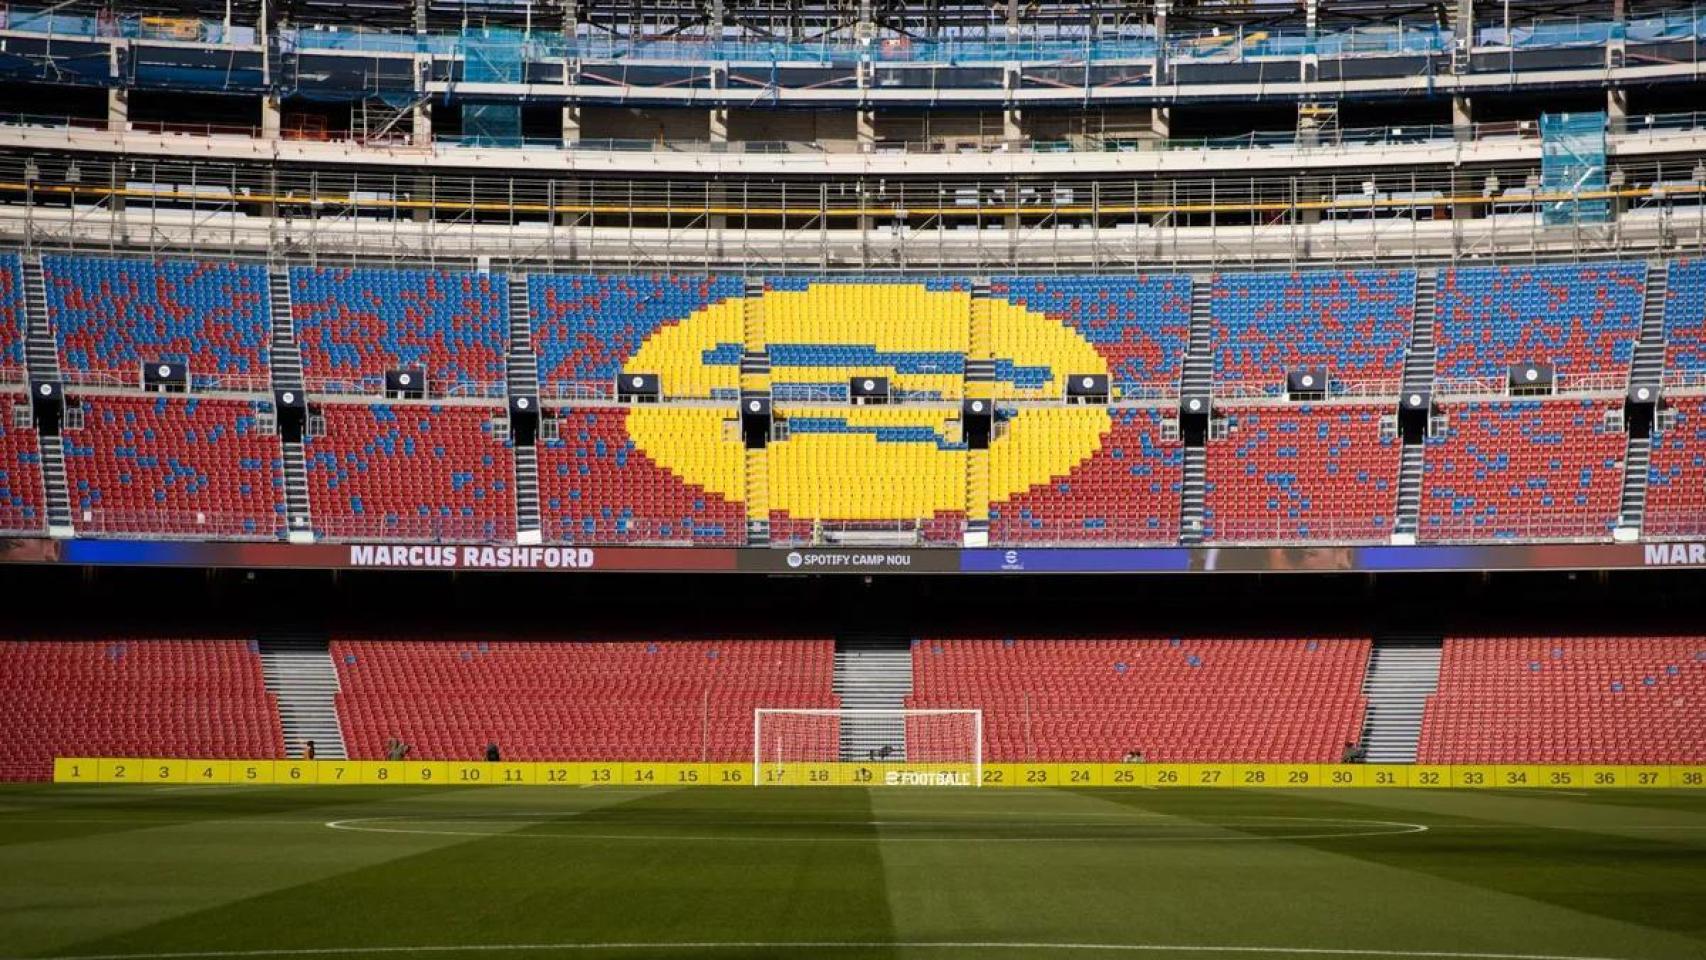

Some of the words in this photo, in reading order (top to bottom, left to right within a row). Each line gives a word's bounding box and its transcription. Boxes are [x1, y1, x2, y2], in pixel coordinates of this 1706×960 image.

[350, 545, 457, 567] MARCUS
[463, 547, 594, 568] RASHFORD
[804, 554, 850, 566] SPOTIFY
[852, 554, 885, 566] CAMP
[886, 554, 911, 566] NOU
[1644, 543, 1706, 565] MAR
[115, 767, 125, 777] 2
[159, 767, 169, 778] 3
[203, 768, 213, 779] 4
[247, 768, 257, 779] 5
[291, 768, 301, 779] 6
[335, 768, 344, 779] 7
[378, 768, 388, 780] 8
[422, 769, 432, 780] 9
[461, 769, 480, 781] 10
[505, 770, 523, 781] 11
[549, 770, 567, 781] 12
[592, 770, 611, 782] 13
[636, 770, 655, 782] 14
[680, 770, 698, 782] 15
[723, 771, 742, 782] 16
[809, 771, 829, 782] 18
[984, 771, 1004, 783] 22
[1027, 771, 1047, 783] 23
[1071, 771, 1090, 783] 24
[1114, 771, 1134, 783] 25
[1158, 771, 1178, 783] 26
[1202, 771, 1221, 783] 27
[1245, 771, 1265, 783] 28
[1289, 771, 1309, 783] 29
[1333, 771, 1353, 783] 30
[1376, 772, 1395, 784] 31
[1420, 772, 1440, 784] 32
[1464, 772, 1484, 784] 33
[1507, 772, 1527, 784] 34
[1551, 772, 1571, 784] 35
[1595, 772, 1615, 784] 36
[1638, 772, 1658, 784] 37
[1682, 772, 1703, 785] 38
